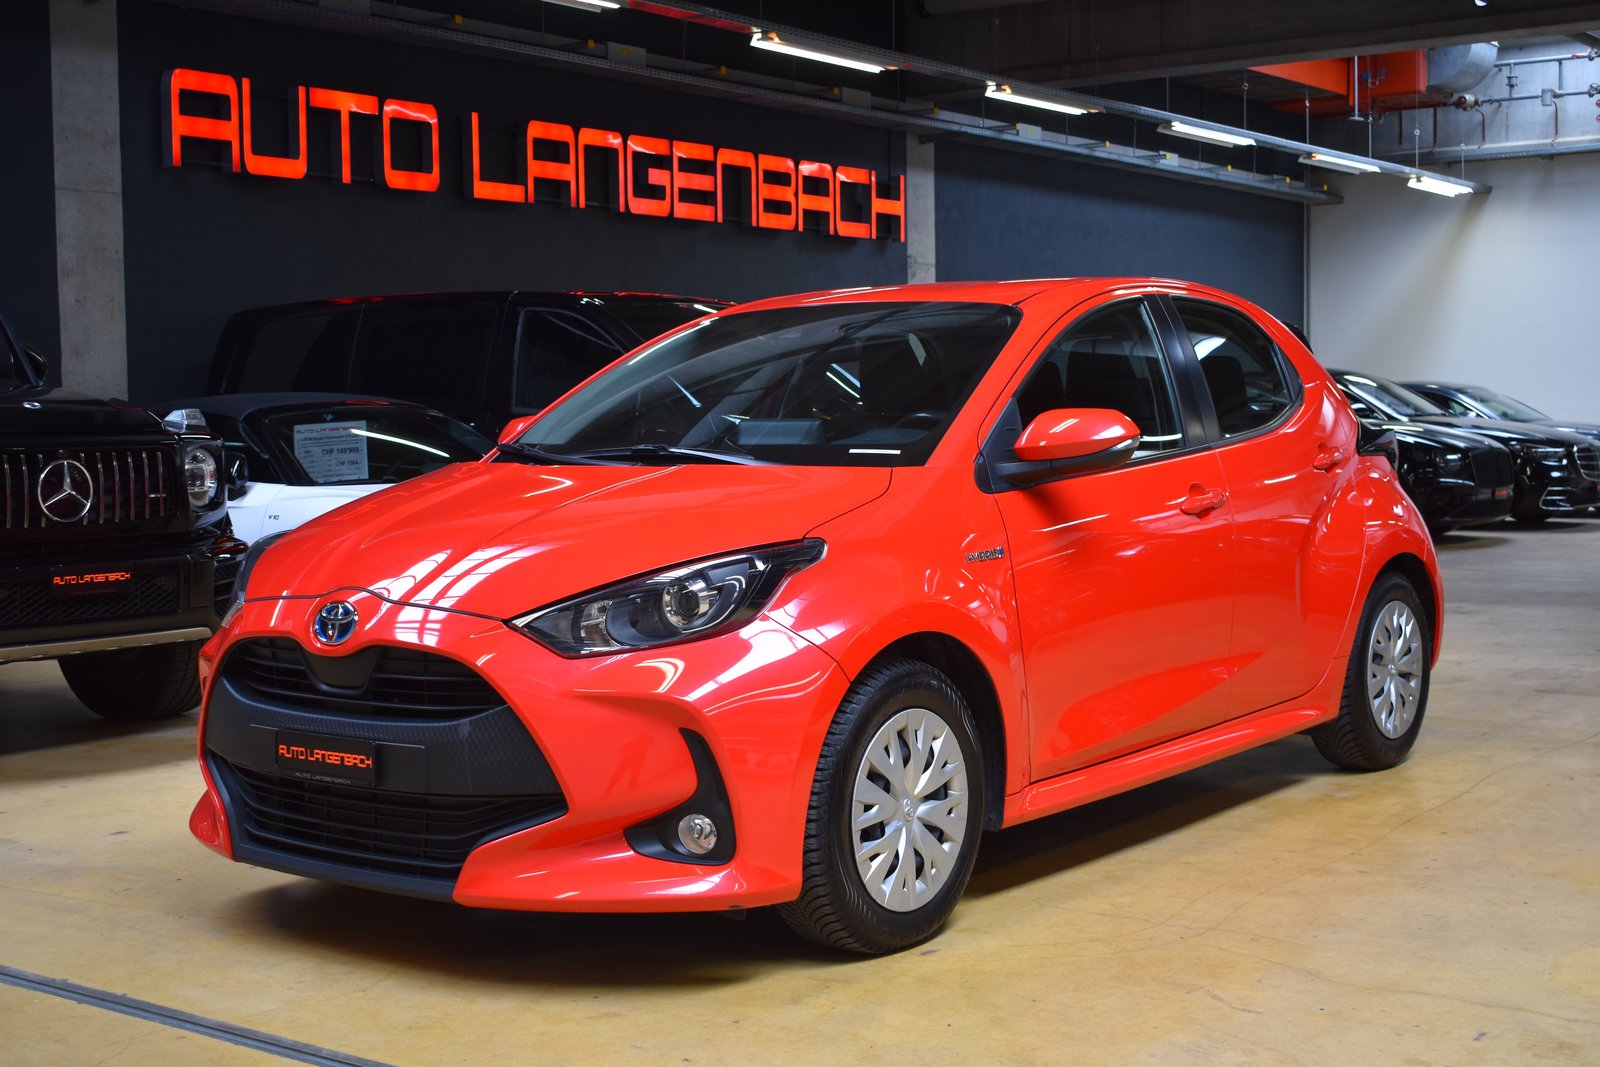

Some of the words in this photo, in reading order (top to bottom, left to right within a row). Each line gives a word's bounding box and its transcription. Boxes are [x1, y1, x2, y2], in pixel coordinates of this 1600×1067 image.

[169, 68, 439, 193] AUTO
[471, 111, 906, 243] LANGENBACH
[53, 575, 77, 585] AUTO
[79, 571, 131, 583] LANGENBACH
[279, 745, 305, 760] AUTO
[308, 748, 372, 768] LANGENBACH
